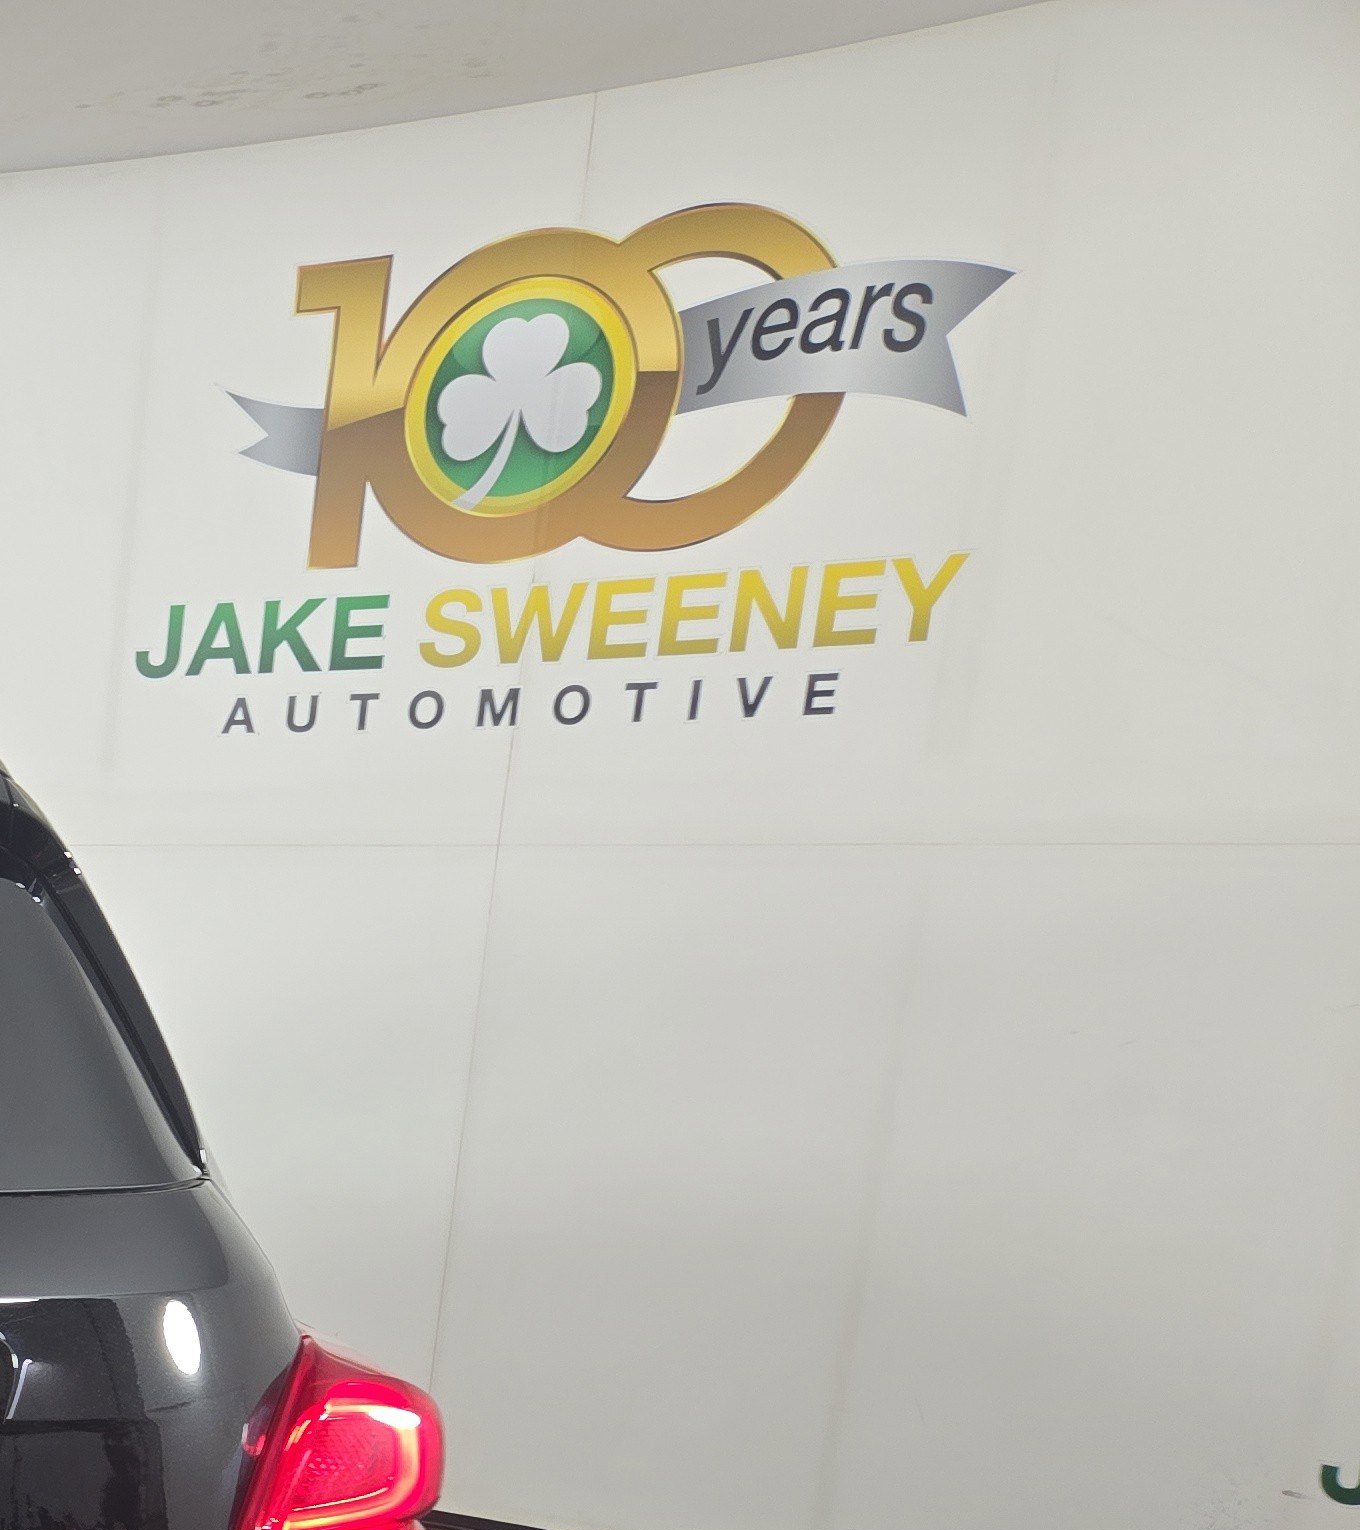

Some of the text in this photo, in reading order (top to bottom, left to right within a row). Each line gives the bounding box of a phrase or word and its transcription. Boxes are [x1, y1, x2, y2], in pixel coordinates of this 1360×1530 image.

[293, 201, 847, 570] 100
[694, 279, 934, 396] years
[135, 552, 969, 679] JAKE SWEENEY
[222, 672, 840, 736] AUTOMOTIVE
